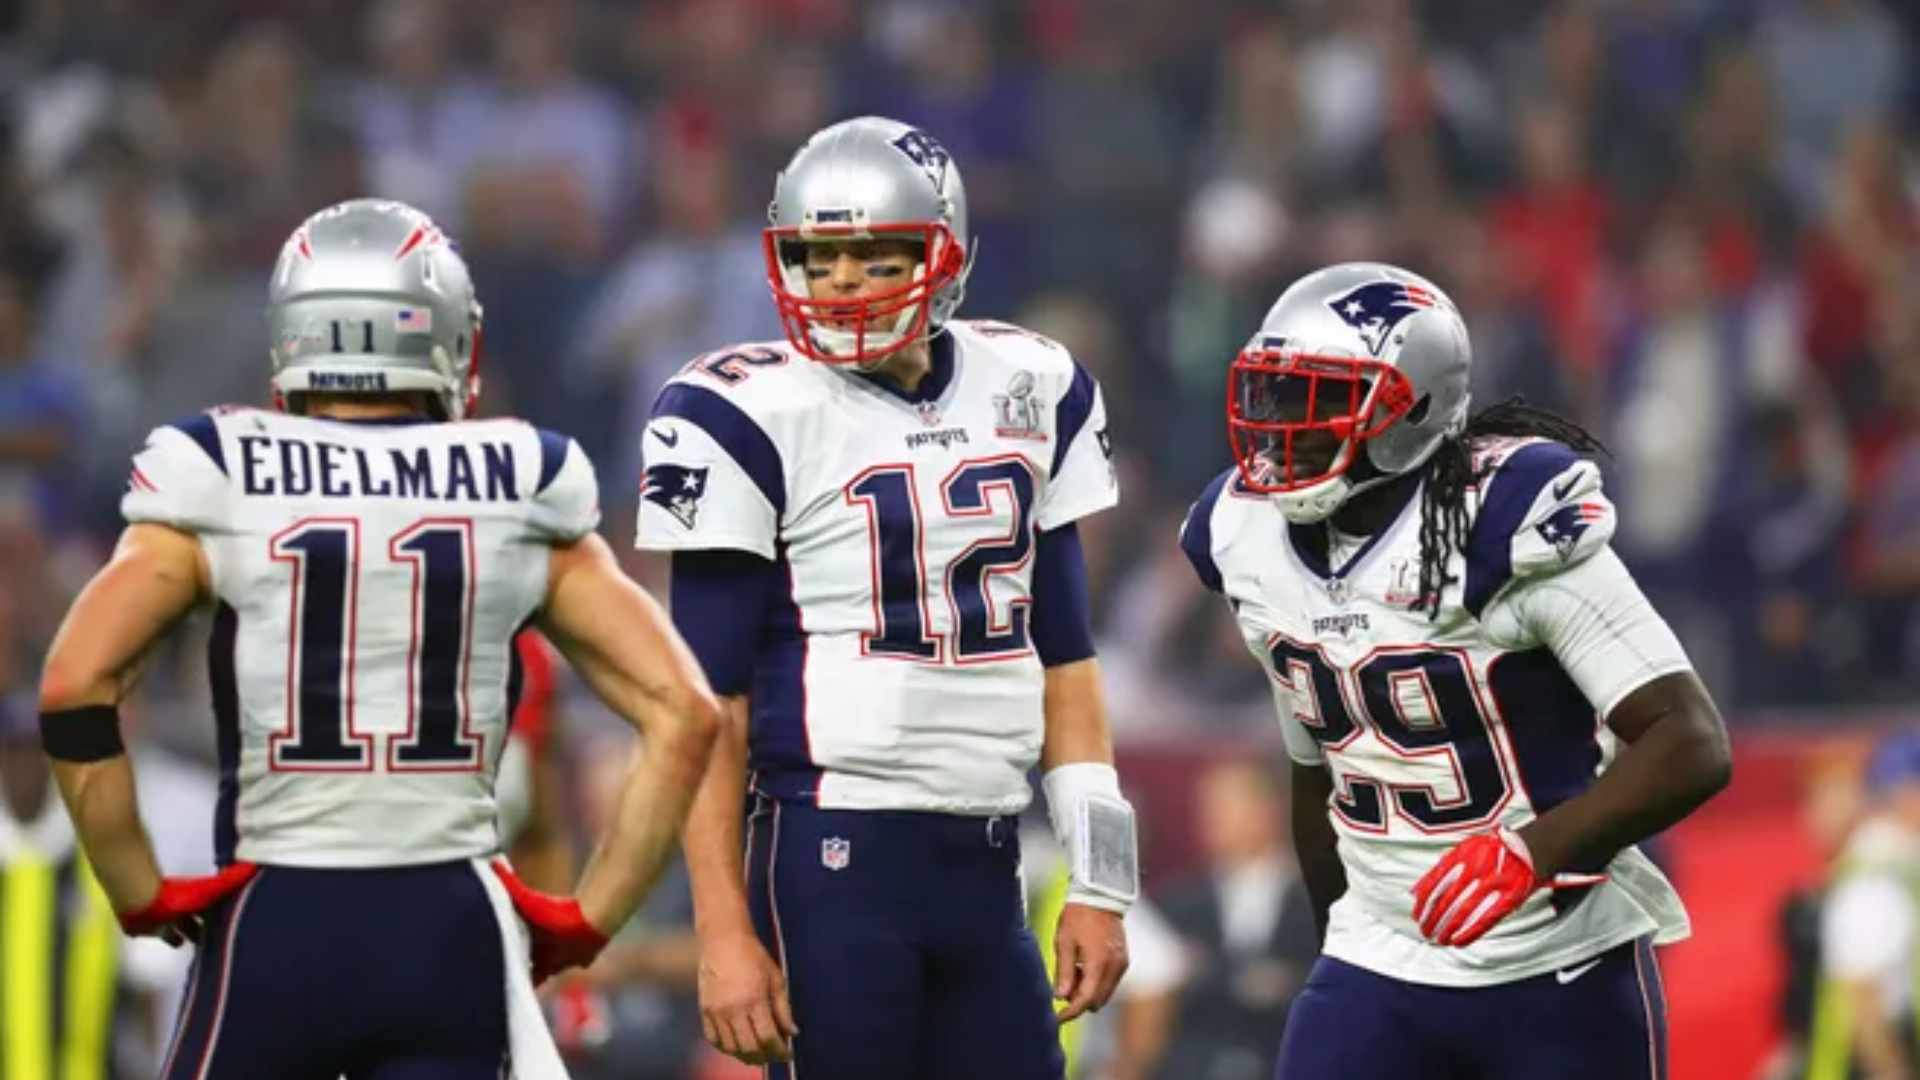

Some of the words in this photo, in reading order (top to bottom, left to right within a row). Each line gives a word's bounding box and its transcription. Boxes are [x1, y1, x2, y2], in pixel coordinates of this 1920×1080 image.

[331, 320, 374, 353] 11
[308, 371, 388, 391] PATRIOTS
[904, 427, 969, 450] PATRIOTS
[238, 435, 519, 502] EDELMAN
[843, 452, 1036, 666] 12
[268, 517, 484, 773] 11
[1312, 613, 1370, 638] PATRIOTS
[1266, 632, 1514, 835] 29
